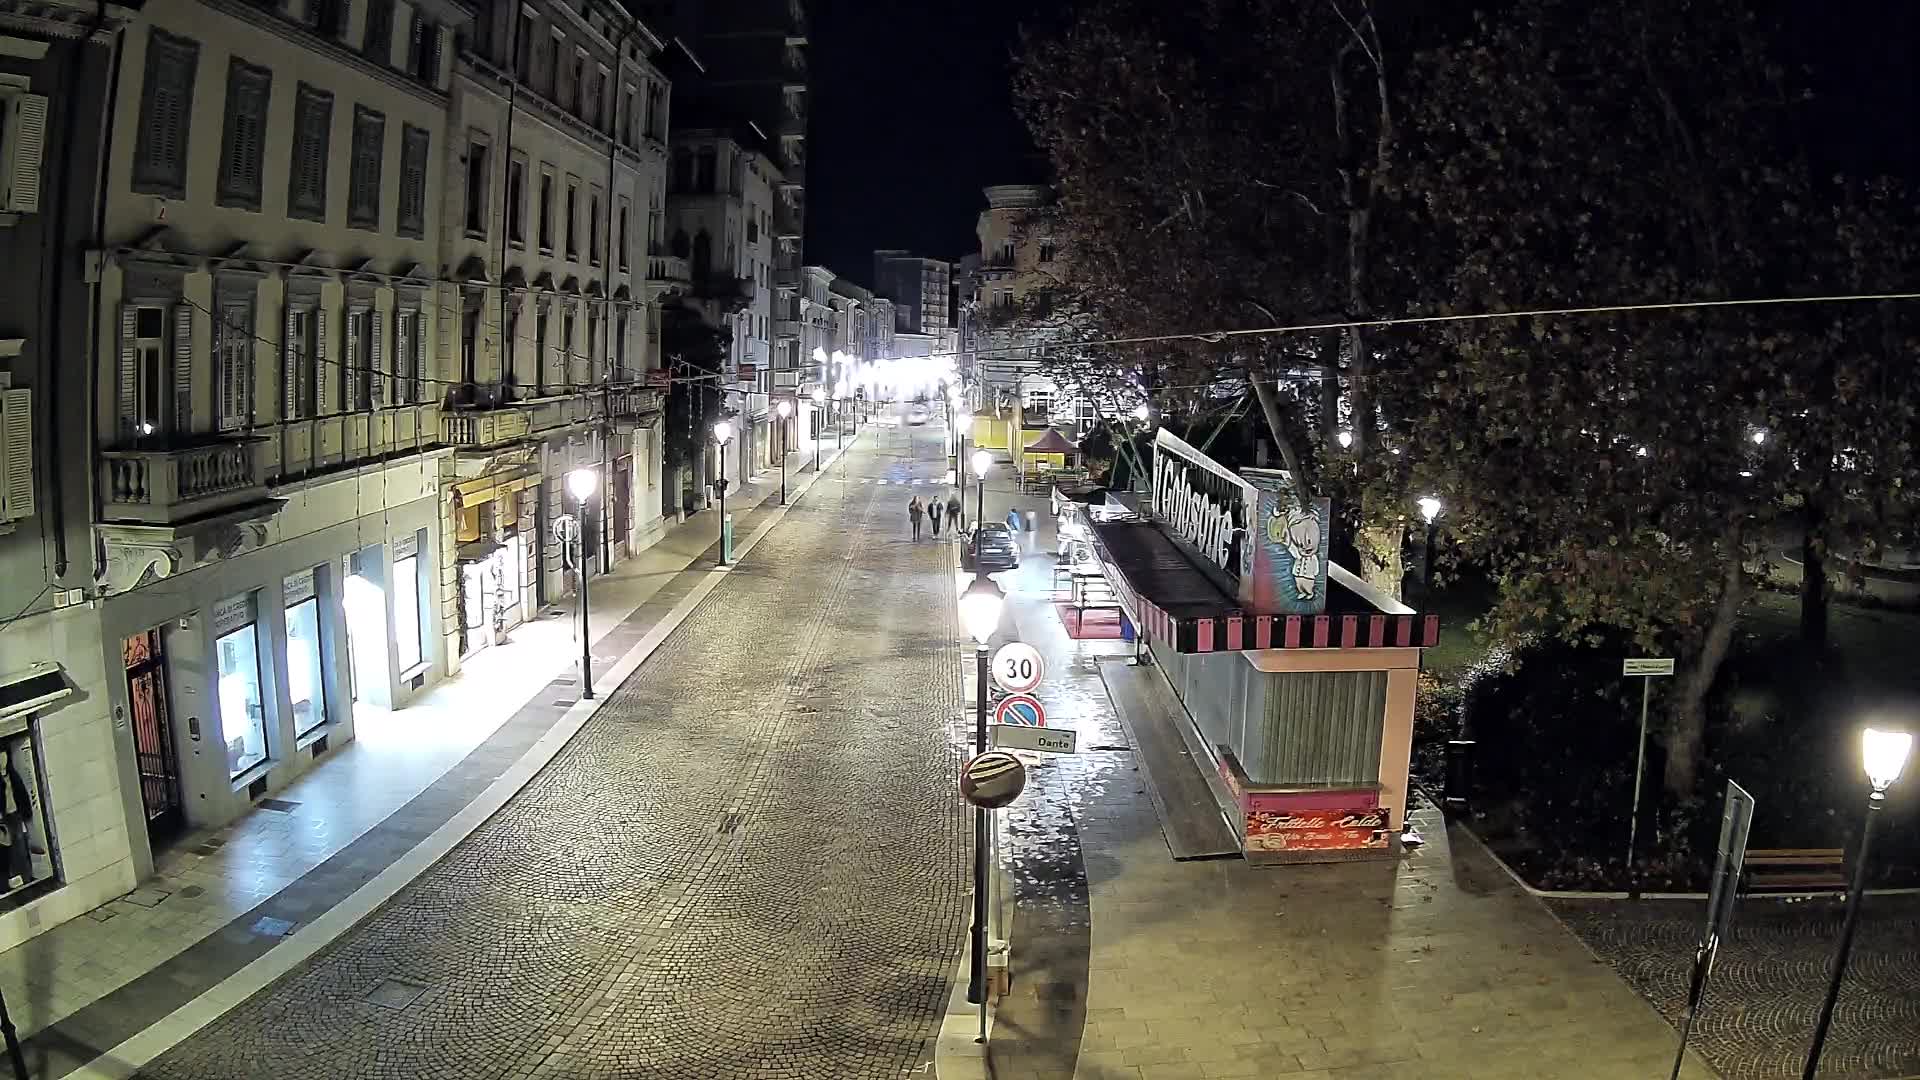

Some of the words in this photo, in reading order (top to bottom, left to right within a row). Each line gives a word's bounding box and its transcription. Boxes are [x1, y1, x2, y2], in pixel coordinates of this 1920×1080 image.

[1162, 458, 1233, 570] Golosone
[1006, 658, 1032, 679] 30
[1038, 737, 1069, 749] Dante
